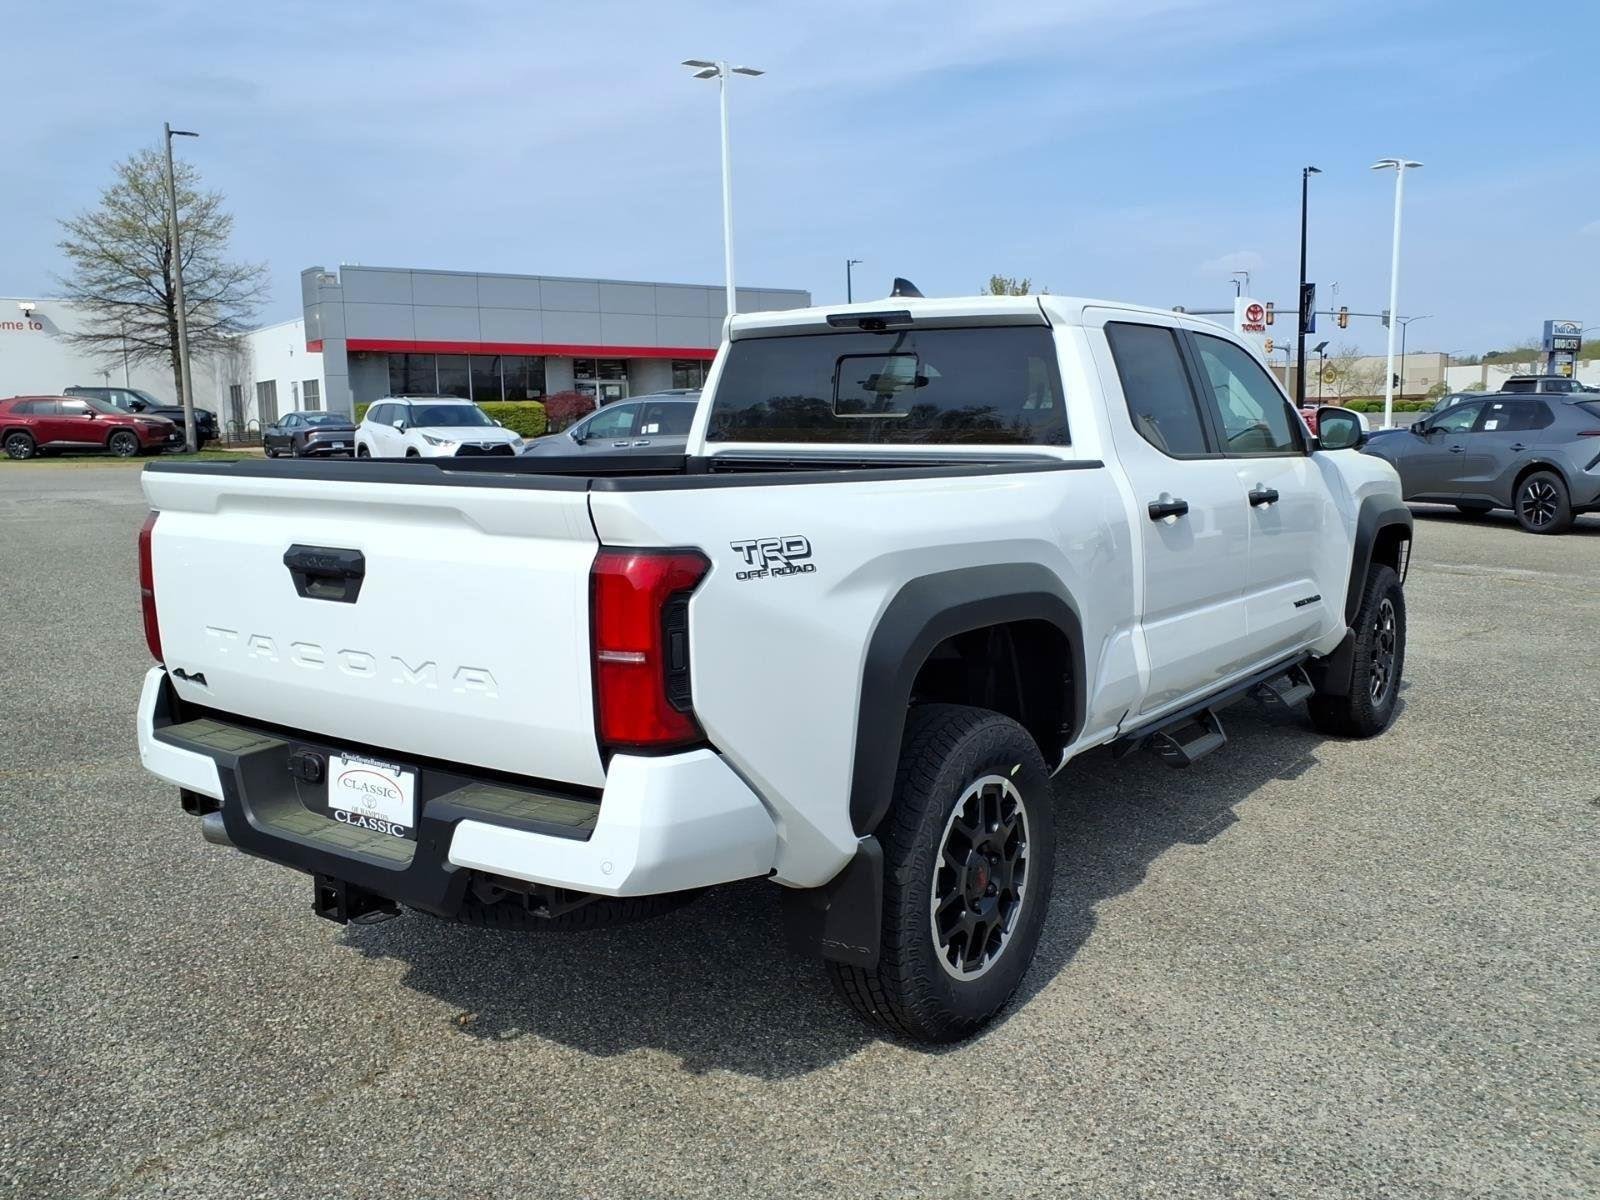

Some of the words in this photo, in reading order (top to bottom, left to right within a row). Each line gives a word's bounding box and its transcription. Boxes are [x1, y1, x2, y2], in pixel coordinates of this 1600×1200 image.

[0, 321, 24, 331] me
[28, 320, 43, 331] to
[1241, 323, 1265, 332] TOYOTA
[730, 534, 812, 569] TRD
[735, 568, 769, 581] OFF
[771, 563, 816, 578] ROAD
[204, 625, 500, 699] TACOMA
[342, 777, 397, 800] CLASSIC
[334, 809, 405, 838] CLASSIC
